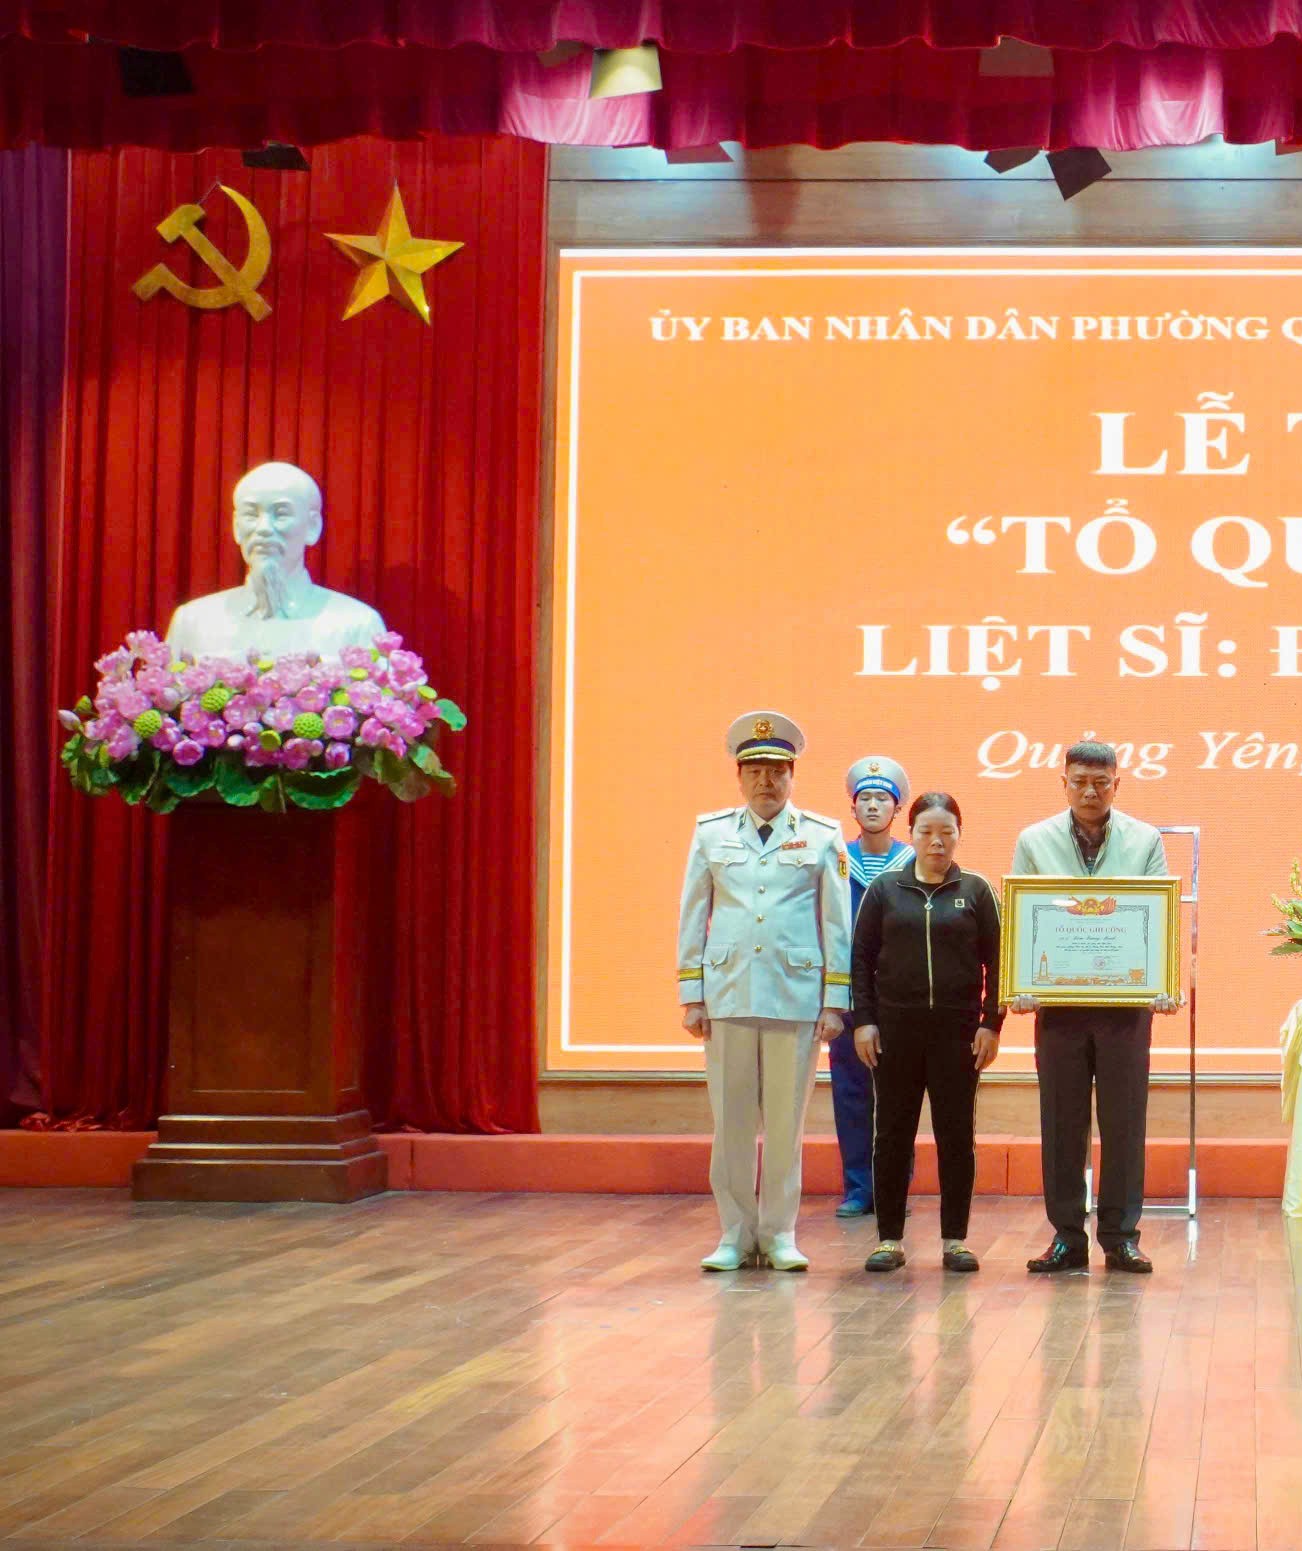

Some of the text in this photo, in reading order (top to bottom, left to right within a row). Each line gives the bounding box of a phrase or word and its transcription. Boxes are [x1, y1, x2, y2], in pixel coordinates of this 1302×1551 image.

[649, 308, 712, 342] ỦY
[722, 315, 816, 342] BAN
[825, 308, 954, 342] NHÂN
[964, 307, 1061, 342] DÂN
[1072, 308, 1271, 342] PHƯỜNG
[1093, 391, 1251, 476] LỄ
[945, 498, 1158, 576] “TỔ
[854, 614, 1092, 692] LIỆT
[1118, 611, 1239, 678] SĨ:
[976, 729, 1174, 781] Qung
